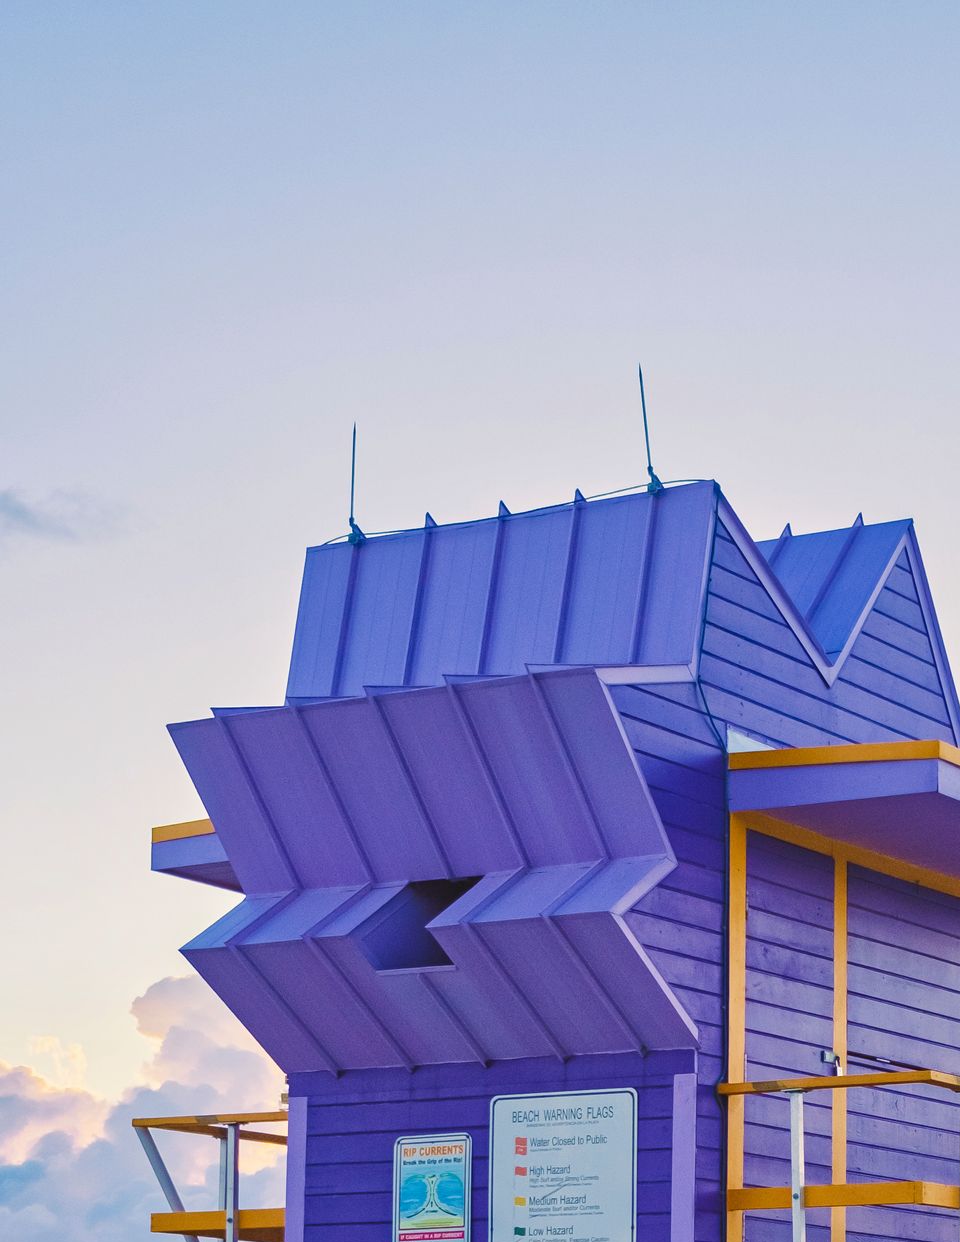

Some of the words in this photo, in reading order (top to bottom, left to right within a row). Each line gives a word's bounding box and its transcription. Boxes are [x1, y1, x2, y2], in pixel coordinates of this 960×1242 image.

[512, 1111, 540, 1123] BEACH
[543, 1108, 582, 1120] WARNING
[587, 1106, 614, 1119] FLAGS
[530, 1137, 550, 1147] Water
[552, 1136, 575, 1146] Closed
[577, 1136, 584, 1145] to
[586, 1135, 608, 1145] Public
[403, 1148, 416, 1157] RIP
[420, 1145, 463, 1156] CURRENTS
[529, 1165, 545, 1177] High
[546, 1164, 571, 1175] Hazard
[529, 1197, 557, 1206] Medium
[559, 1194, 587, 1204] Hazard
[528, 1227, 544, 1236] Low
[546, 1225, 574, 1236] Hazard
